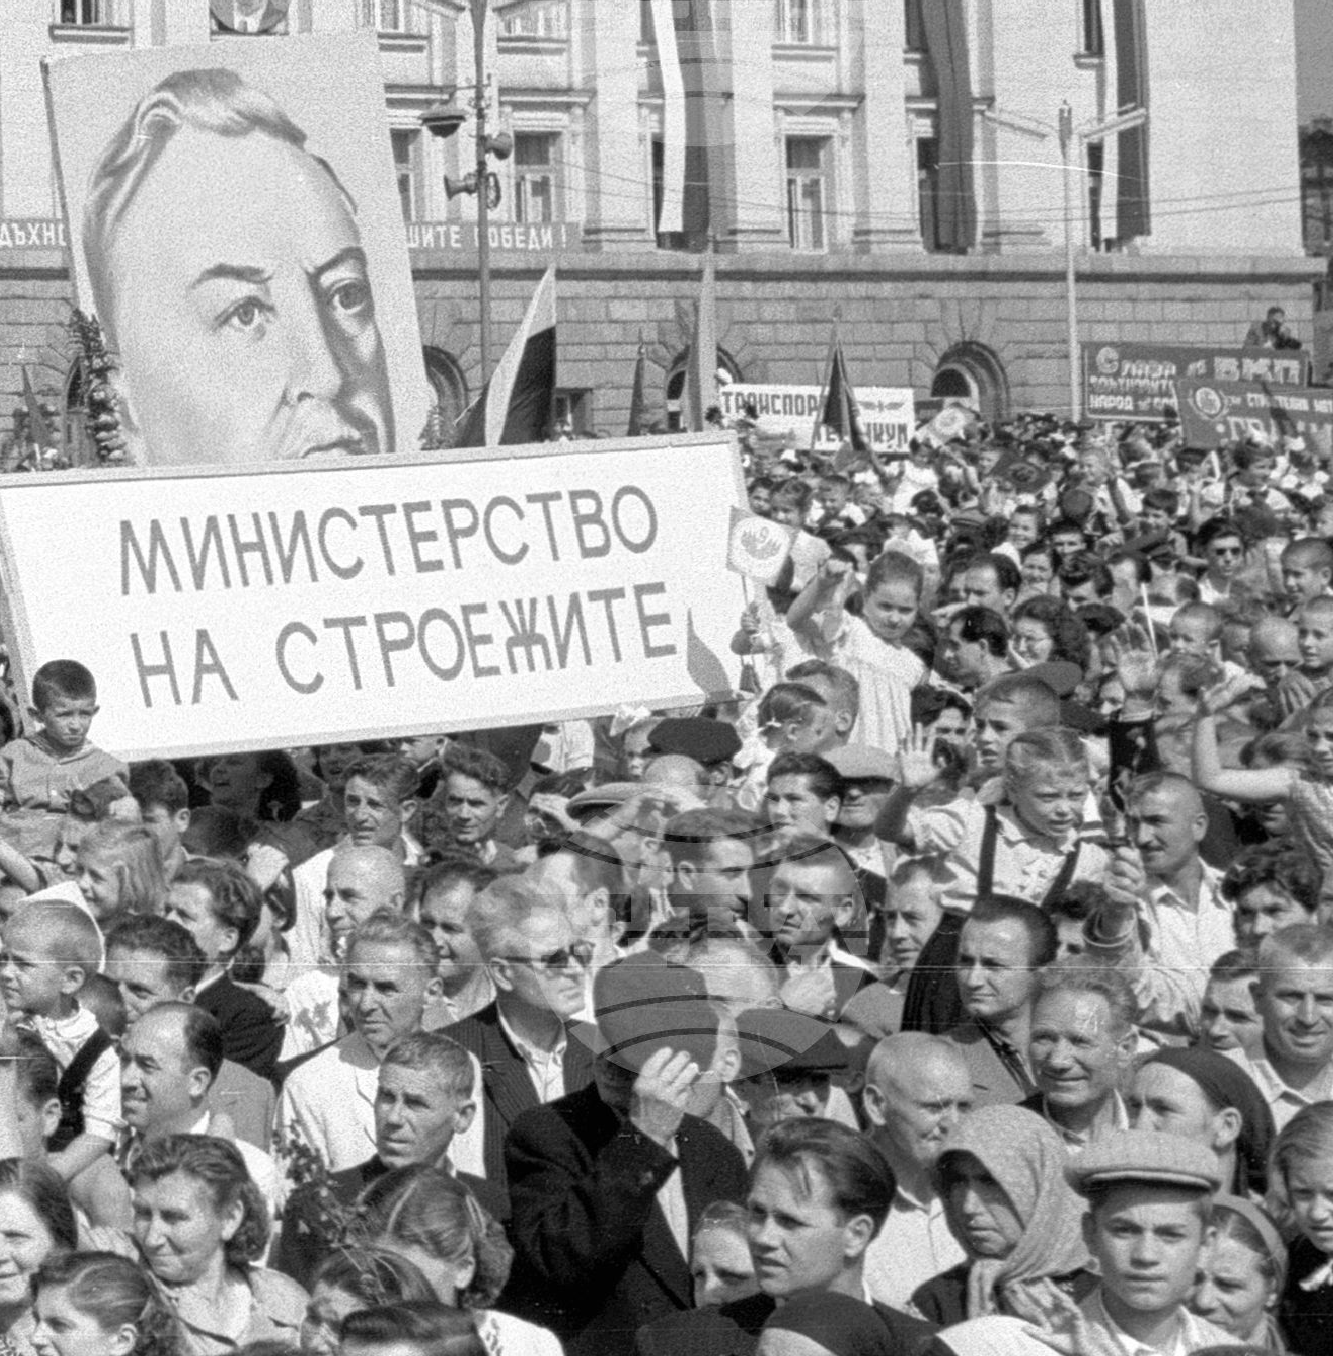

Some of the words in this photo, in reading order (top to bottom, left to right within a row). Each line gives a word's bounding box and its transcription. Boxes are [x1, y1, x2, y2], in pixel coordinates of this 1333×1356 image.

[119, 485, 659, 597] МИНИСТЕРСТВО
[132, 628, 241, 710] НА
[274, 580, 679, 696] СТРОЕЖИТЕ
